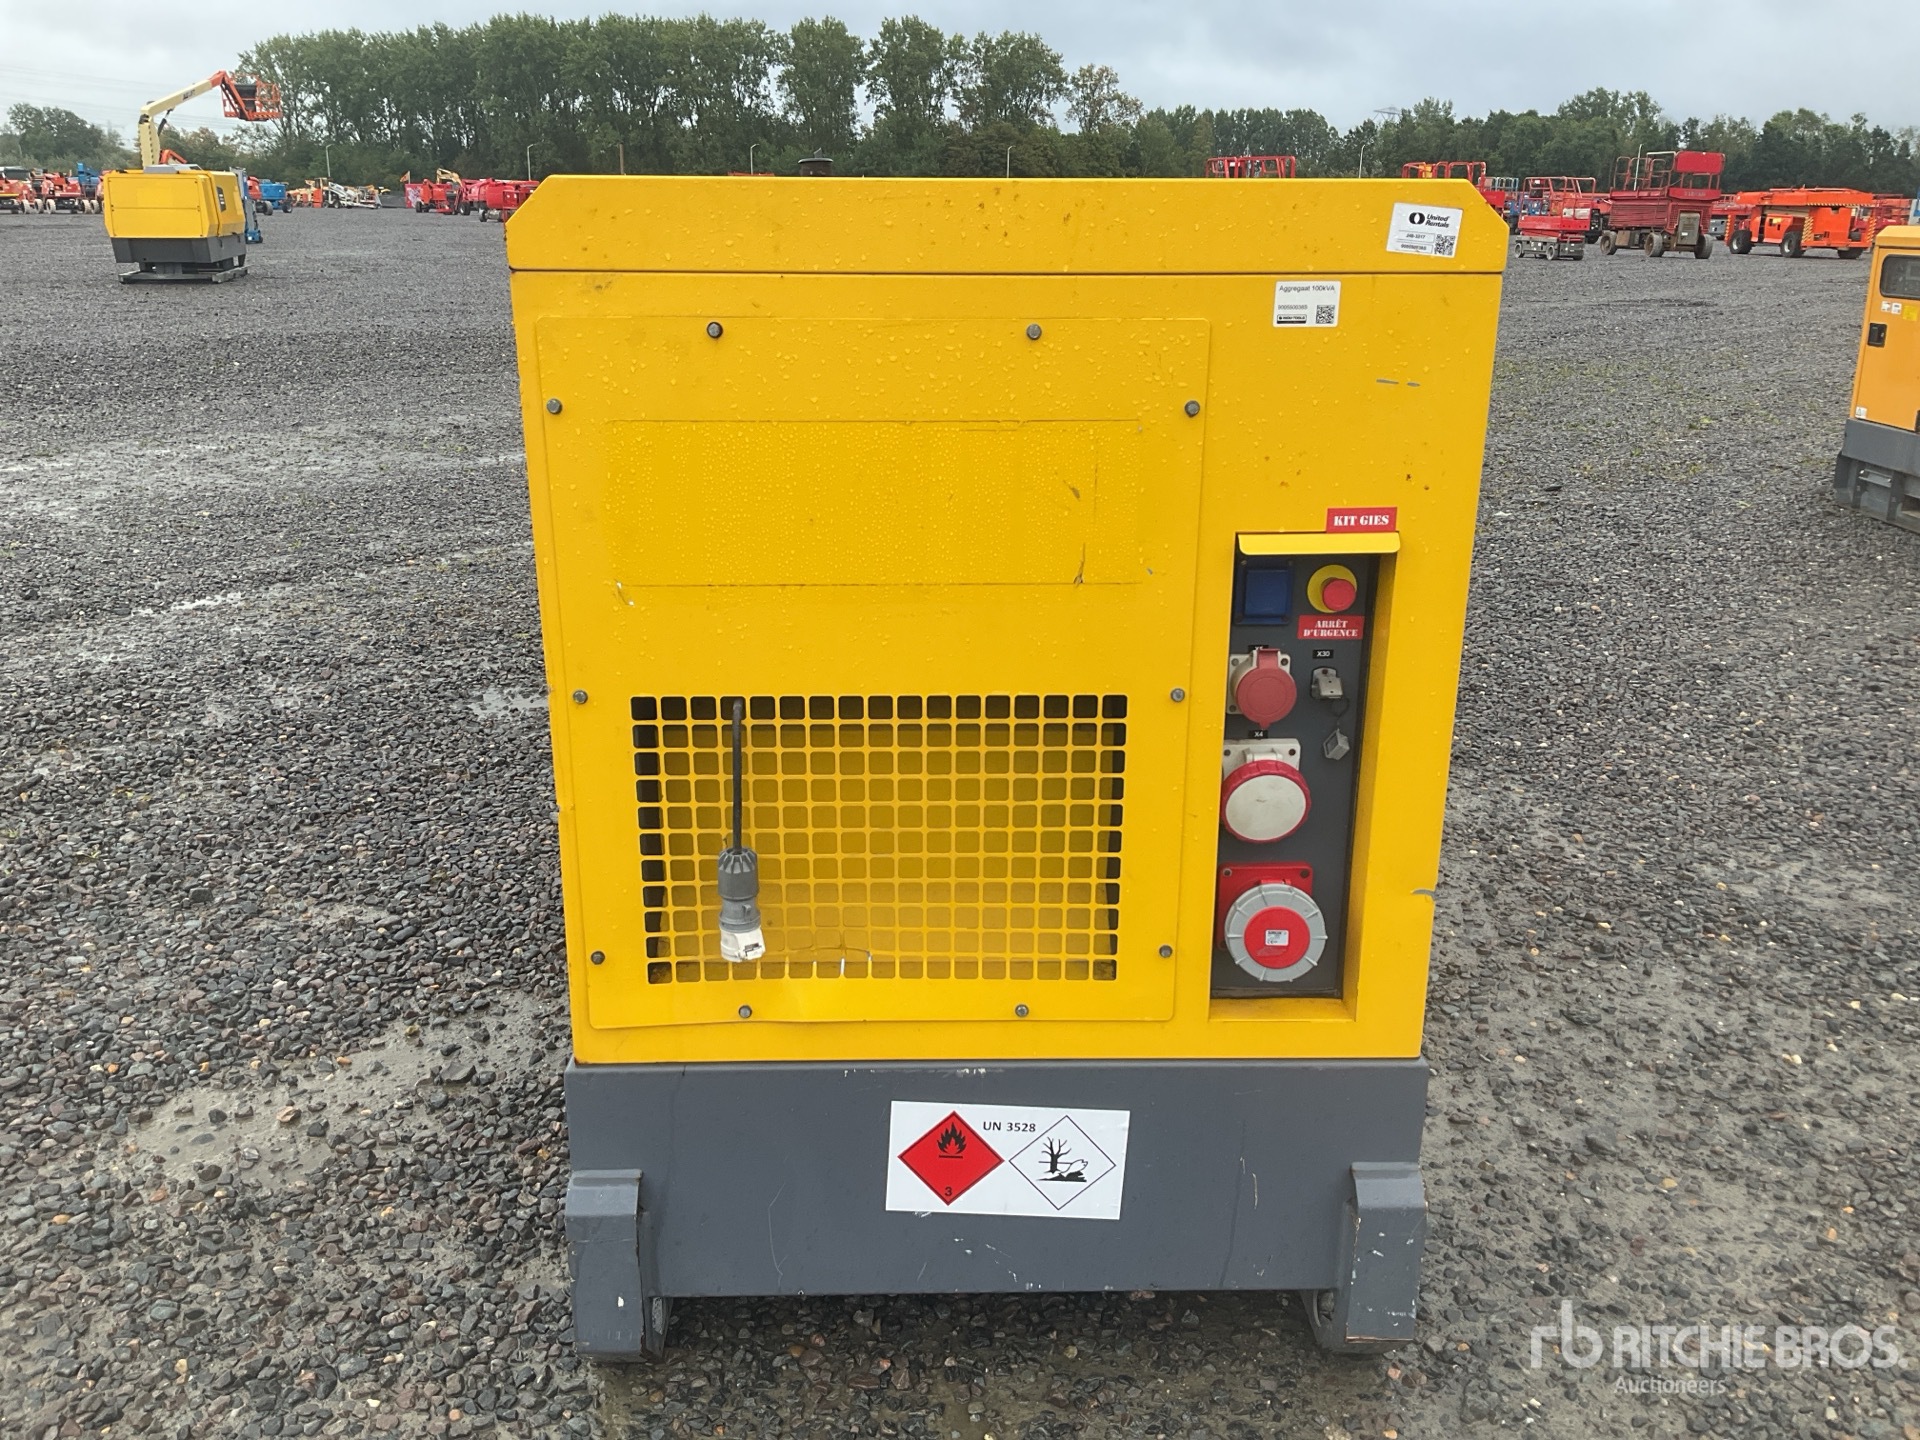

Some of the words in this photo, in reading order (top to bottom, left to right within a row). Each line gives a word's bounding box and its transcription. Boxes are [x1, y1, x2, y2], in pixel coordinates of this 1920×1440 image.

[1427, 214, 1450, 222] United
[1425, 220, 1450, 229] Rentals
[1279, 285, 1311, 293] Aggregaat
[1333, 515, 1357, 527] KIT
[1360, 514, 1389, 526] GIES
[1315, 619, 1348, 629] ARRÊT
[1303, 629, 1358, 637] D'URGENCE
[983, 1121, 1002, 1131] UN
[1006, 1122, 1036, 1132] 3528
[944, 1186, 953, 1197] 3
